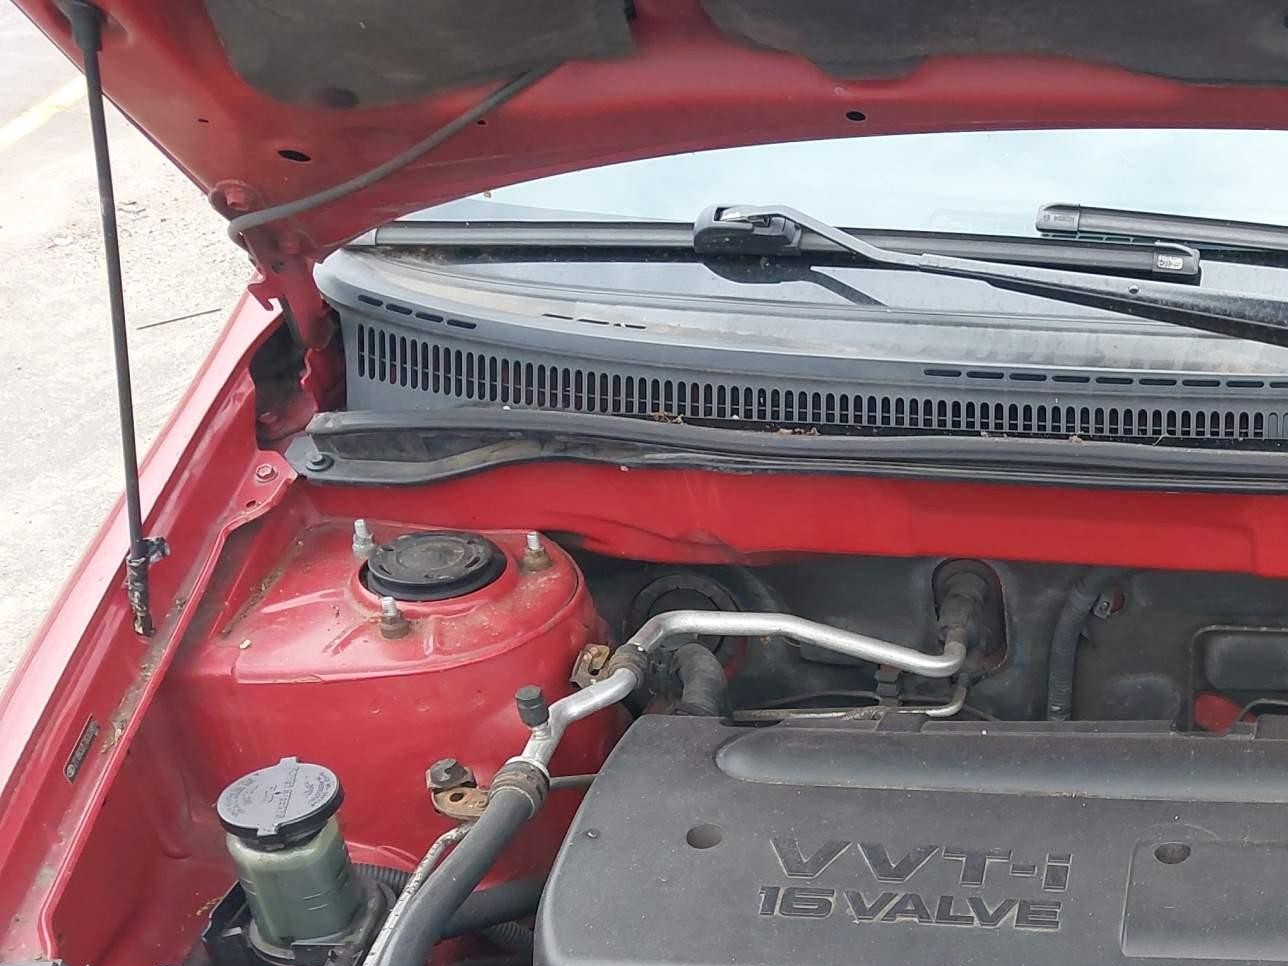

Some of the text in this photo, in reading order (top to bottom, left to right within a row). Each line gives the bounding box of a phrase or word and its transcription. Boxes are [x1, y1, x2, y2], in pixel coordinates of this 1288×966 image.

[769, 838, 1072, 892] VVT-i
[758, 887, 1063, 931] 16 VALVE
